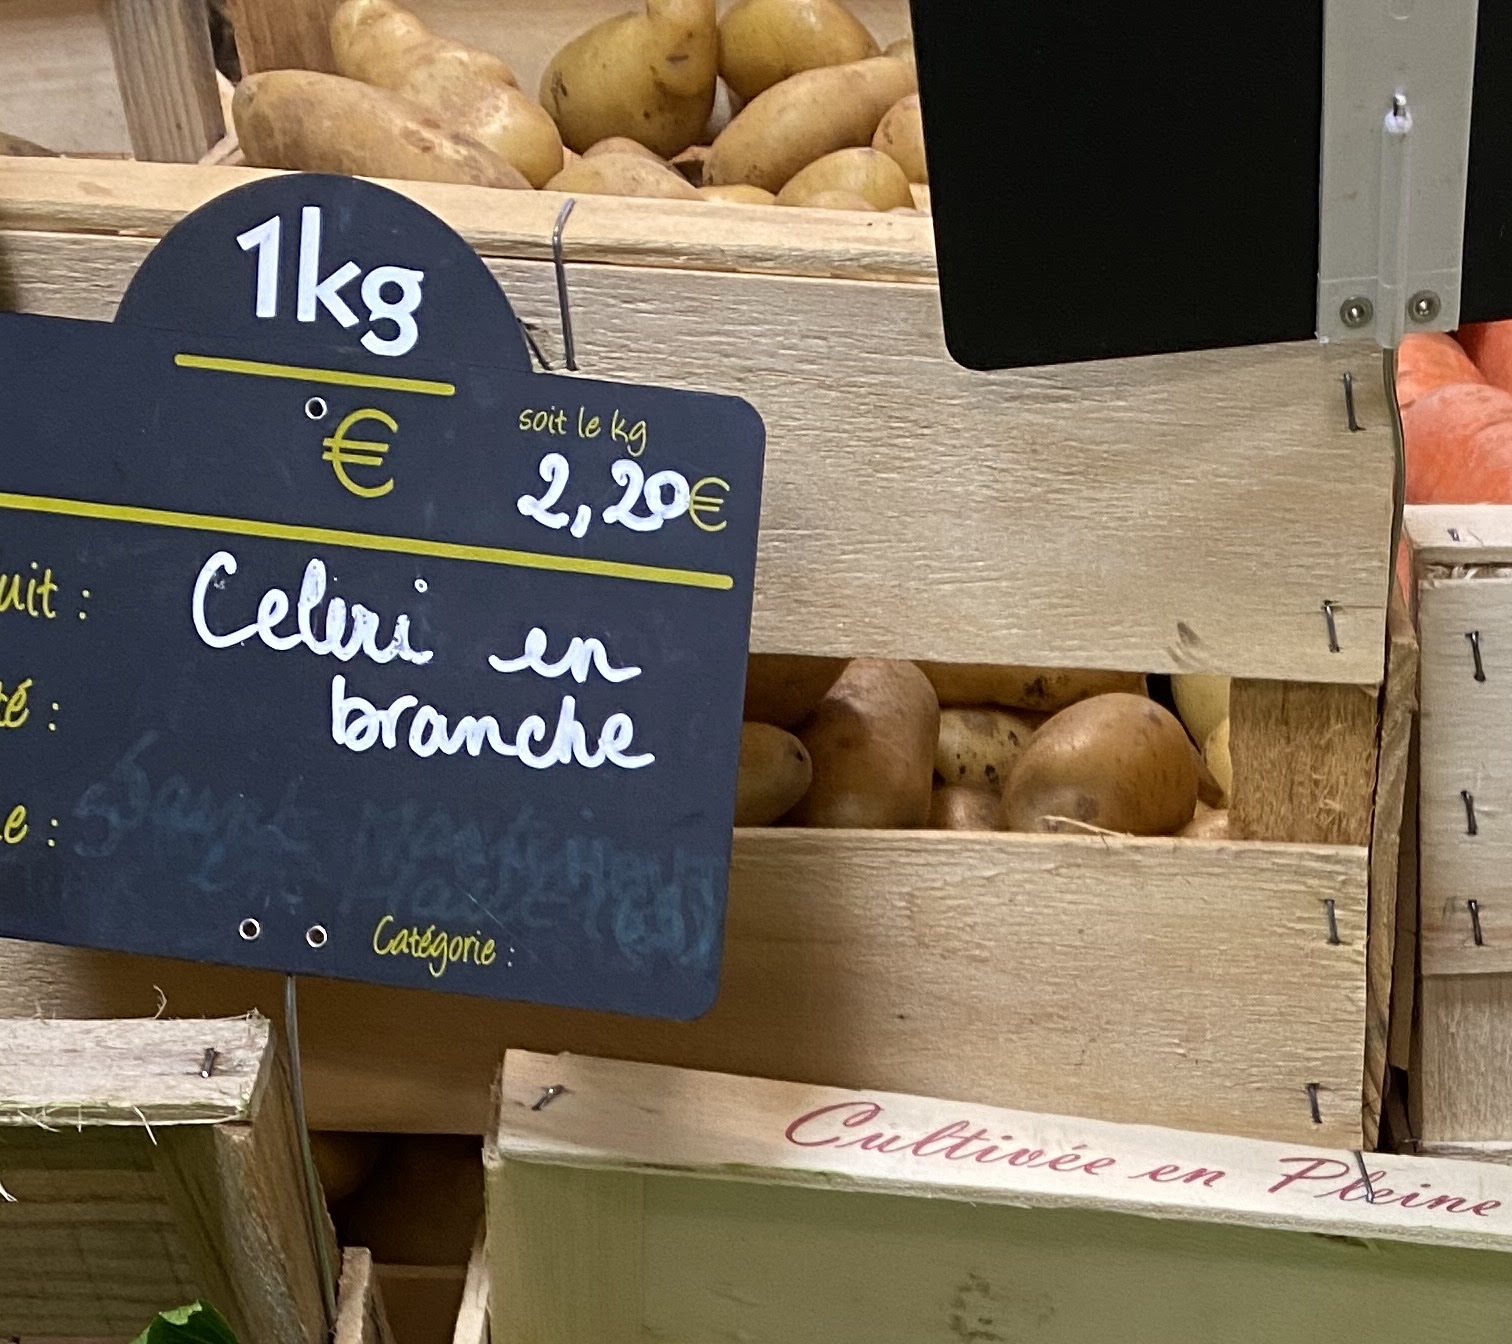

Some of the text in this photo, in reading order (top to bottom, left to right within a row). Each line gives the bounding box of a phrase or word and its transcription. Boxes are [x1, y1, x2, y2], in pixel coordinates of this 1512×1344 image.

[236, 206, 425, 357] 1kg
[322, 408, 399, 499] €
[518, 405, 648, 457] soit le kg
[488, 627, 642, 684] en
[331, 674, 656, 770] branche
[373, 914, 497, 978] Catégorie
[784, 1100, 1117, 1176] Cultivée
[1127, 1160, 1228, 1189] en
[1266, 1156, 1503, 1218] Pleine
